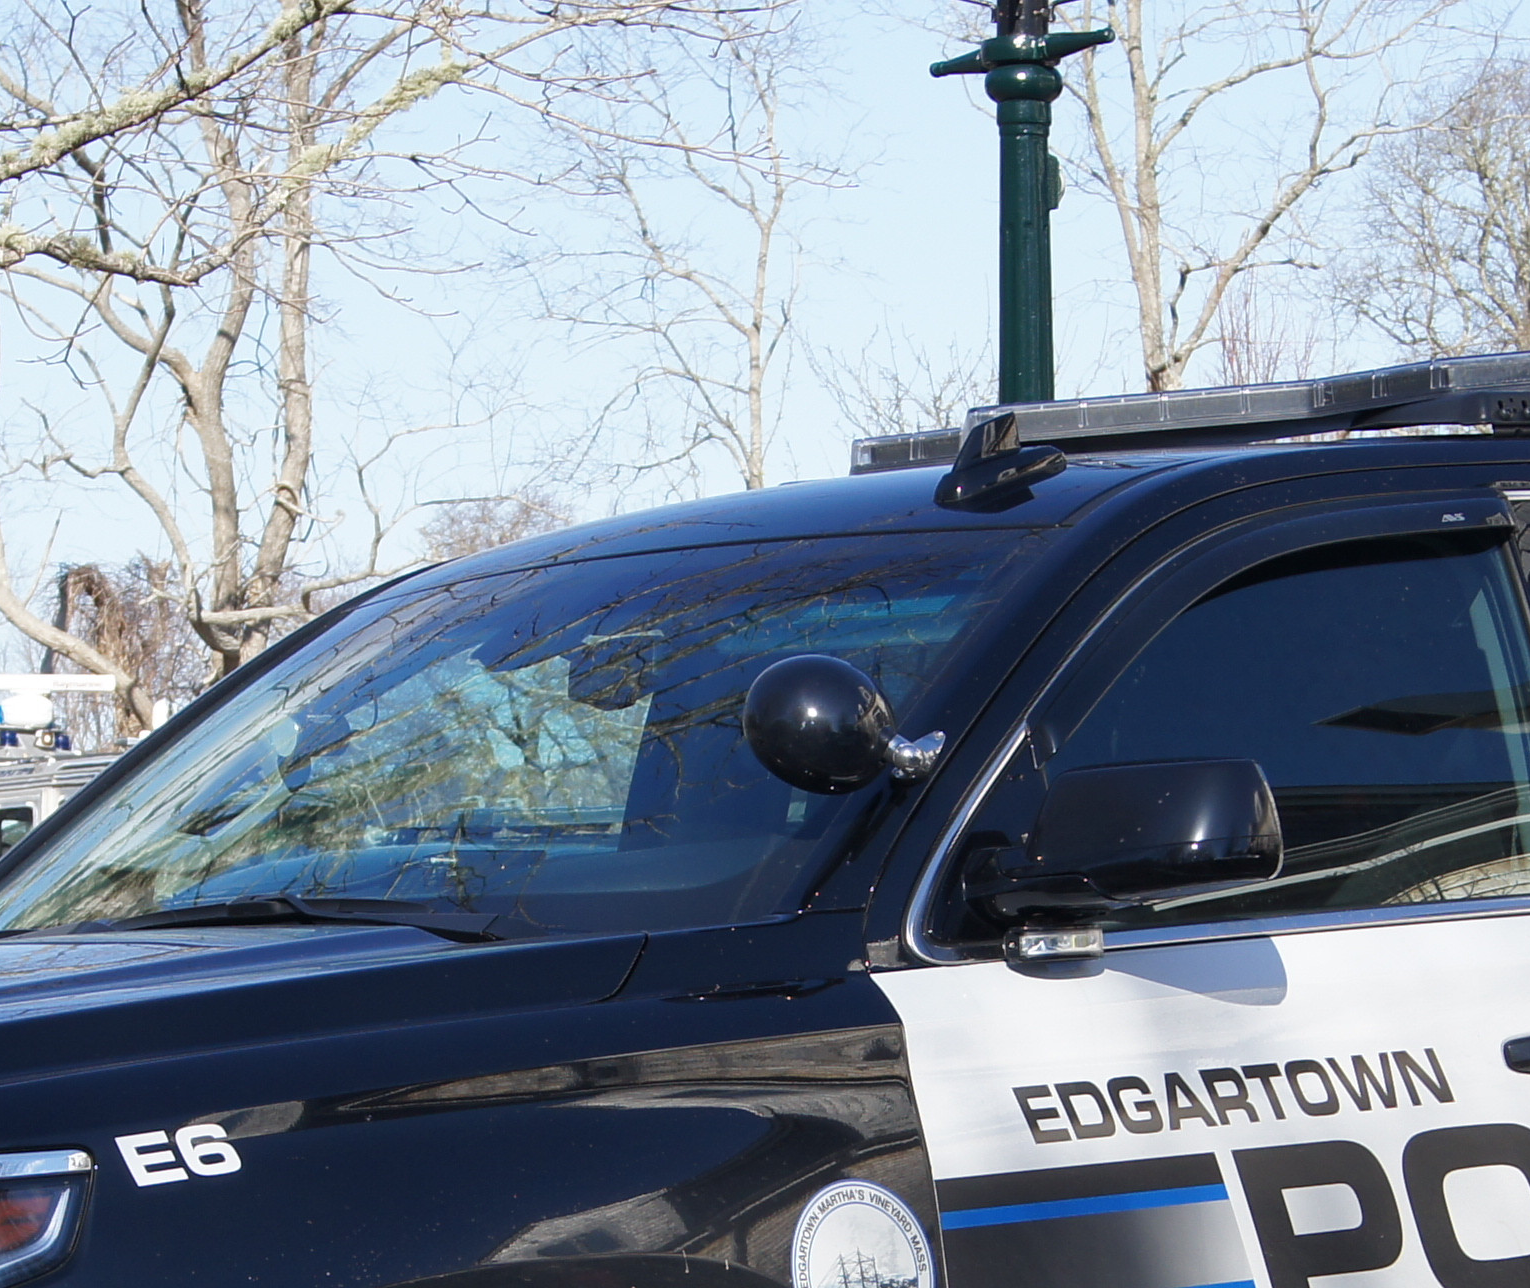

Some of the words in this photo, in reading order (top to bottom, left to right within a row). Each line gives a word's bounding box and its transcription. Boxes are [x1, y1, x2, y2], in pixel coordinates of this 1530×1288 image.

[1011, 1047, 1456, 1146] EDGARTOWN
[114, 1123, 242, 1188] E6
[869, 1191, 913, 1235] VINEYARD
